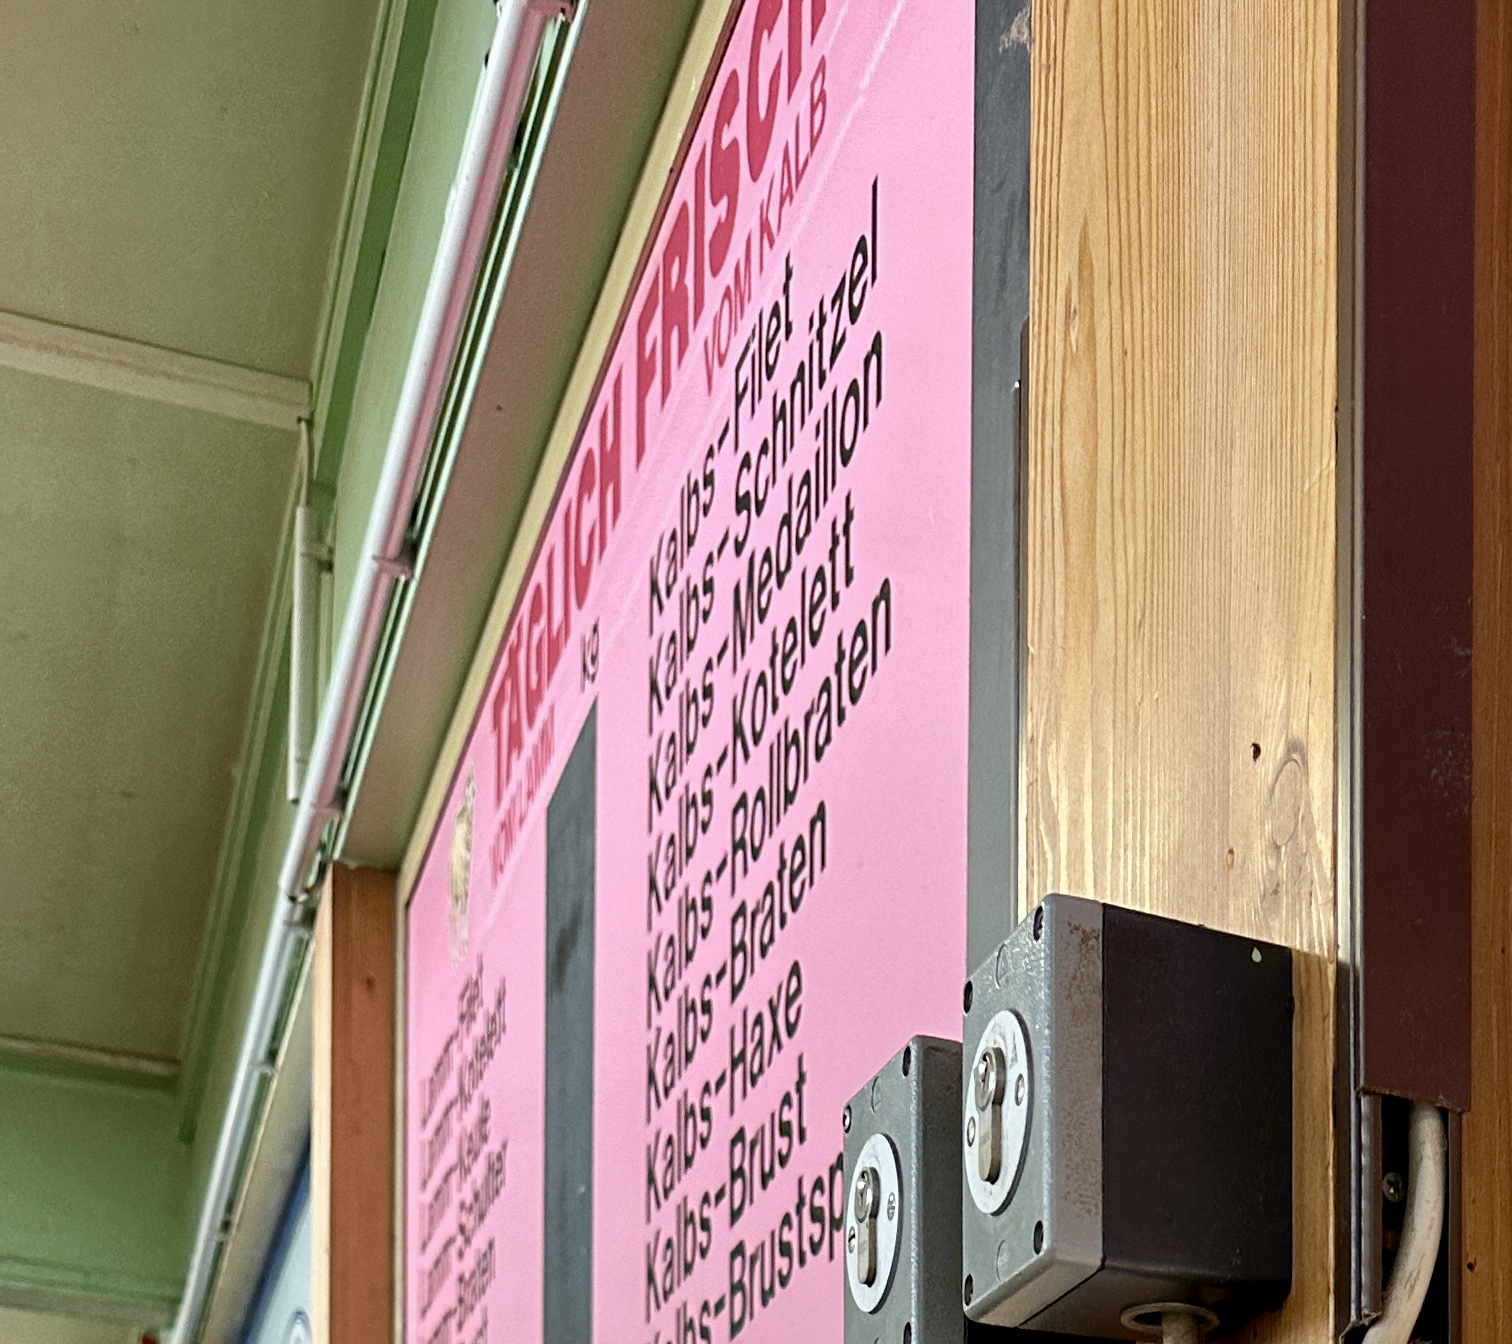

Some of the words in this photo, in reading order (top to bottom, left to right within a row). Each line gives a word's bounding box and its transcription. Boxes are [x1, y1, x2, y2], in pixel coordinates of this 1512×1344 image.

[704, 230, 752, 397] VOM
[759, 54, 827, 278] KALB
[492, 364, 623, 812] TÄGLICH
[648, 175, 879, 736] Kalbs-Schnitzel
[648, 330, 884, 833] Kalbs-Medaillon
[649, 251, 793, 636] Kalbs-Filet
[647, 490, 855, 931] Kalbs-Kotelett
[647, 577, 892, 1030] Kalbs-Rollbraten
[646, 800, 828, 1124] Kalbs-Braten
[646, 959, 804, 1223] Kalbs-Haxe
[646, 1053, 807, 1323] Kalbs-Brust
